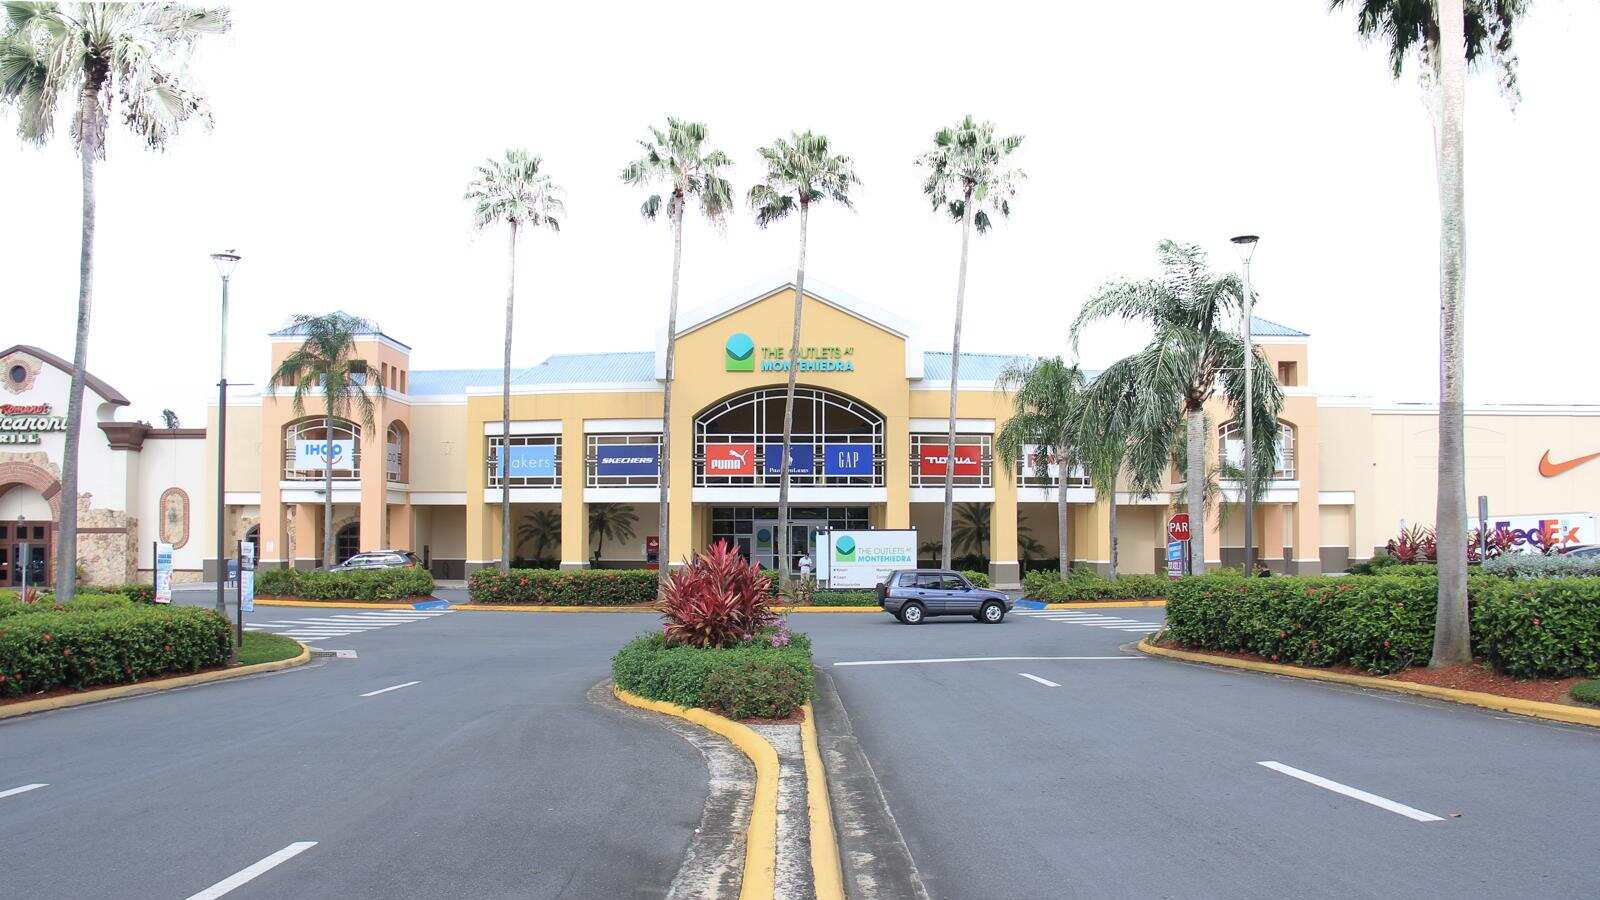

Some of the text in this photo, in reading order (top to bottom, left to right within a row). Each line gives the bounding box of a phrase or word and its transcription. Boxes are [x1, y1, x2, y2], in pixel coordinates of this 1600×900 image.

[761, 347, 784, 359] THE
[761, 361, 854, 371] MONEHIEDRA
[511, 455, 550, 468] akers
[711, 459, 741, 469] PUMA
[838, 451, 859, 468] GAP
[1170, 522, 1188, 532] PAR
[1495, 519, 1581, 546] FedEx
[858, 547, 872, 555] THE
[874, 547, 904, 555] OUTLETS
